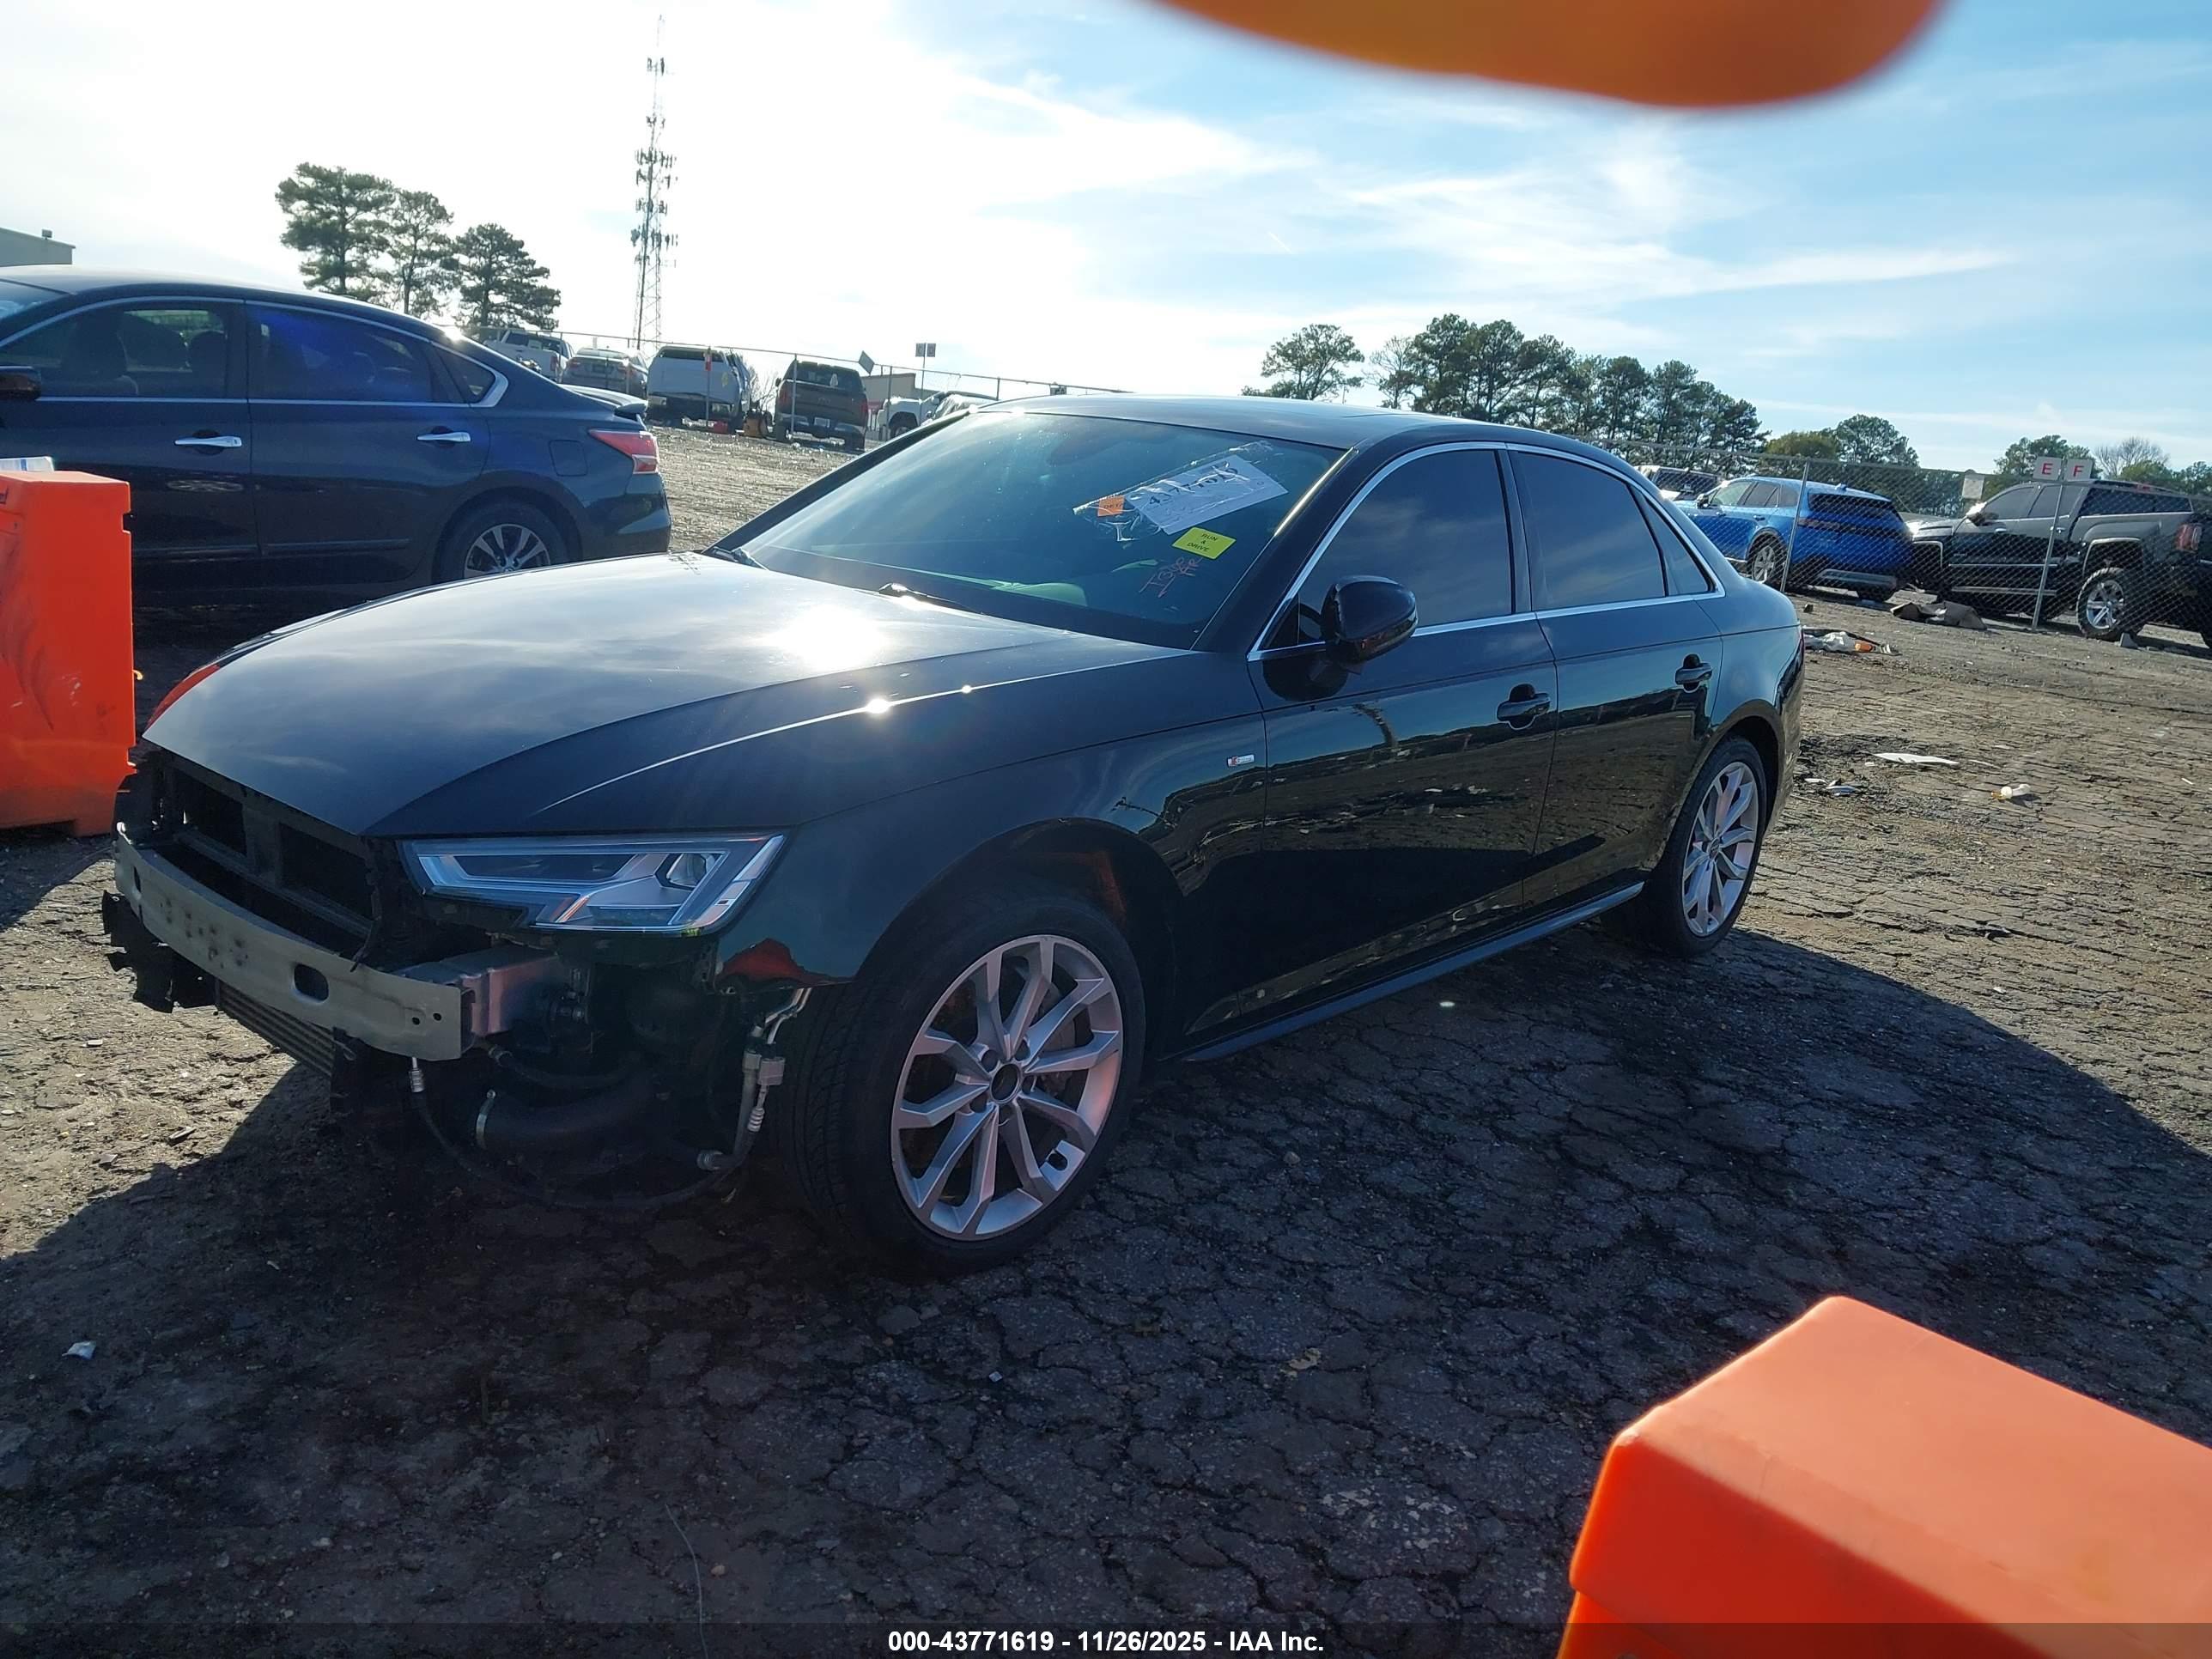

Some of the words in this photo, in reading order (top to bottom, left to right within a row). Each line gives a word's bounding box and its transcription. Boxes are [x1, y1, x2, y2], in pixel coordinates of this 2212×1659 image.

[2041, 462, 2053, 475] E
[2073, 465, 2085, 477] F
[1200, 532, 1218, 542] RUN
[1187, 542, 1210, 552] DRIVE
